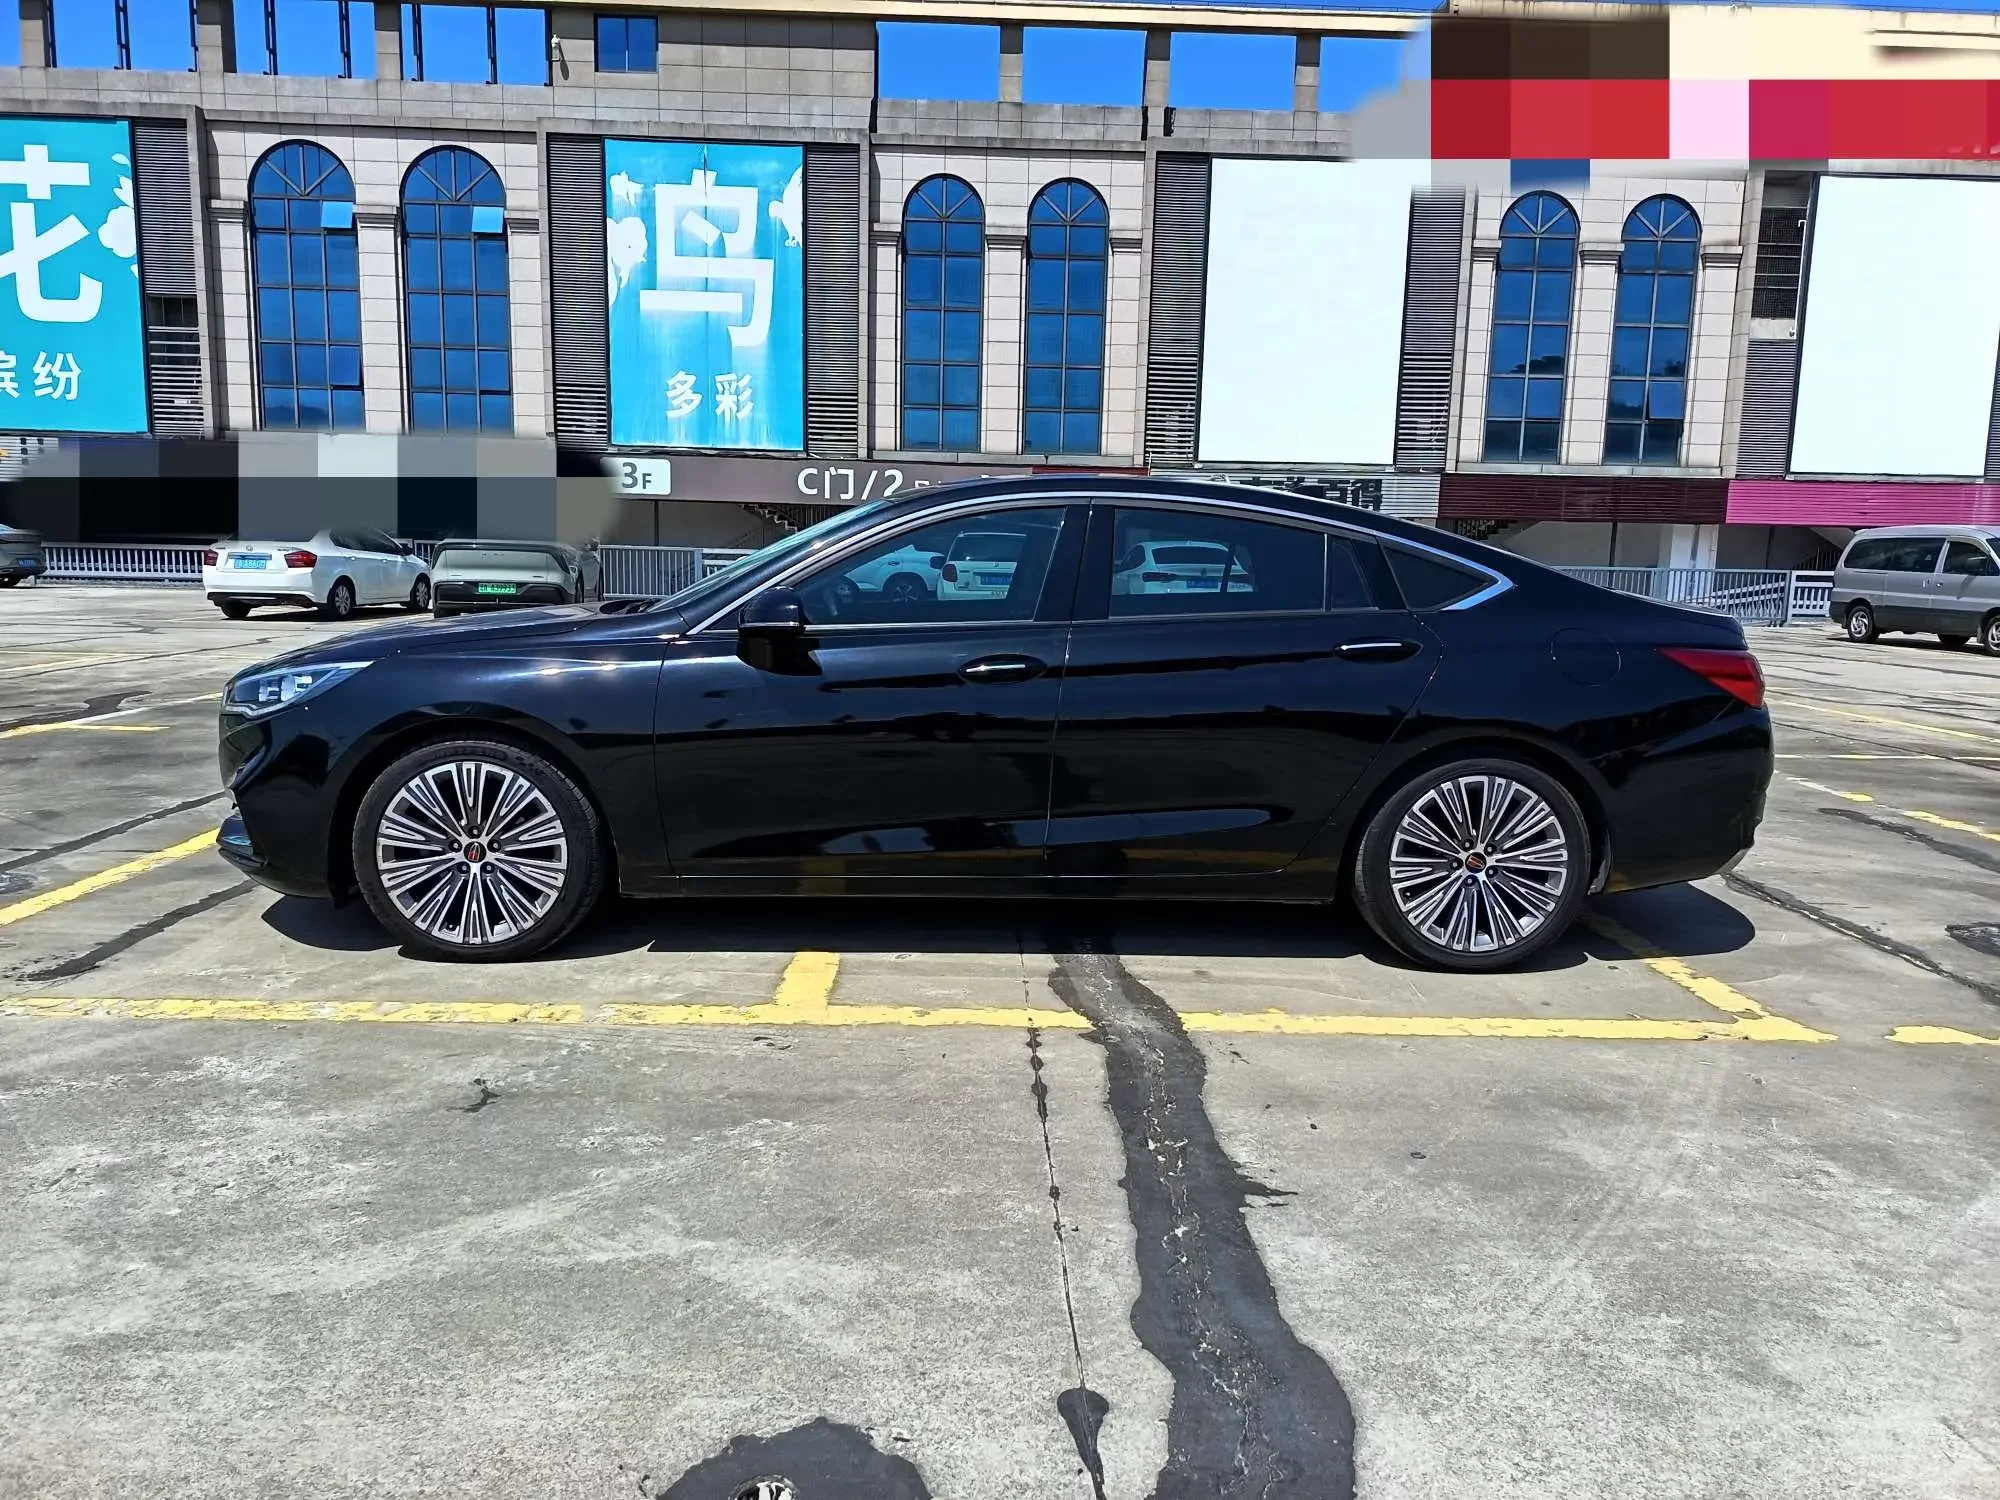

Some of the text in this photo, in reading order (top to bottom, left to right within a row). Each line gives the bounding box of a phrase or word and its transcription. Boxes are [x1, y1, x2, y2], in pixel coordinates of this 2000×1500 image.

[0, 144, 103, 323] 花
[640, 168, 774, 347] 鸟
[665, 371, 755, 423] 多彩
[621, 461, 653, 490] 3F
